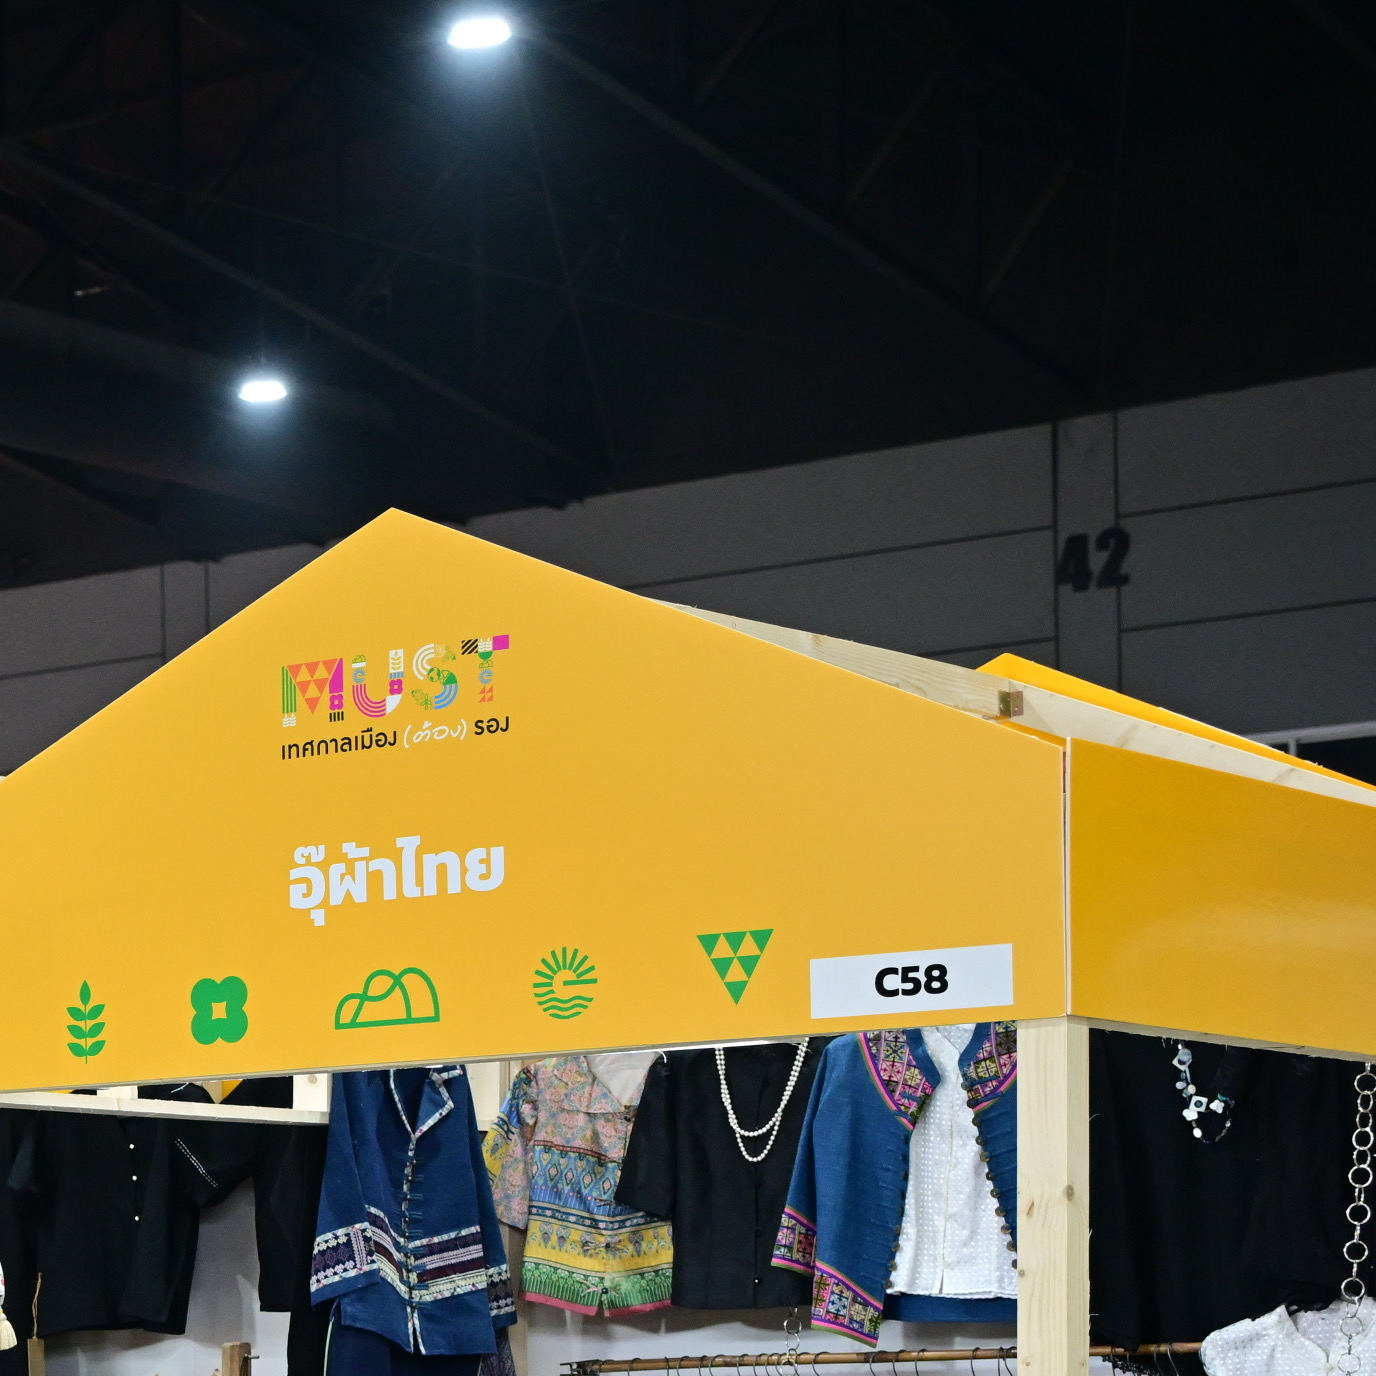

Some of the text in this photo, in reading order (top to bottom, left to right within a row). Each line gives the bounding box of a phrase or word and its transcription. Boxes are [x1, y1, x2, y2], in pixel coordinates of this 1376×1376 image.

[1056, 528, 1130, 593] 42
[281, 634, 509, 728] MUST
[281, 725, 399, 761] เทศกาลเมือง
[473, 713, 510, 737] รอง
[288, 835, 507, 927] อุ๊ผ้าไทย
[873, 964, 949, 998] C58
